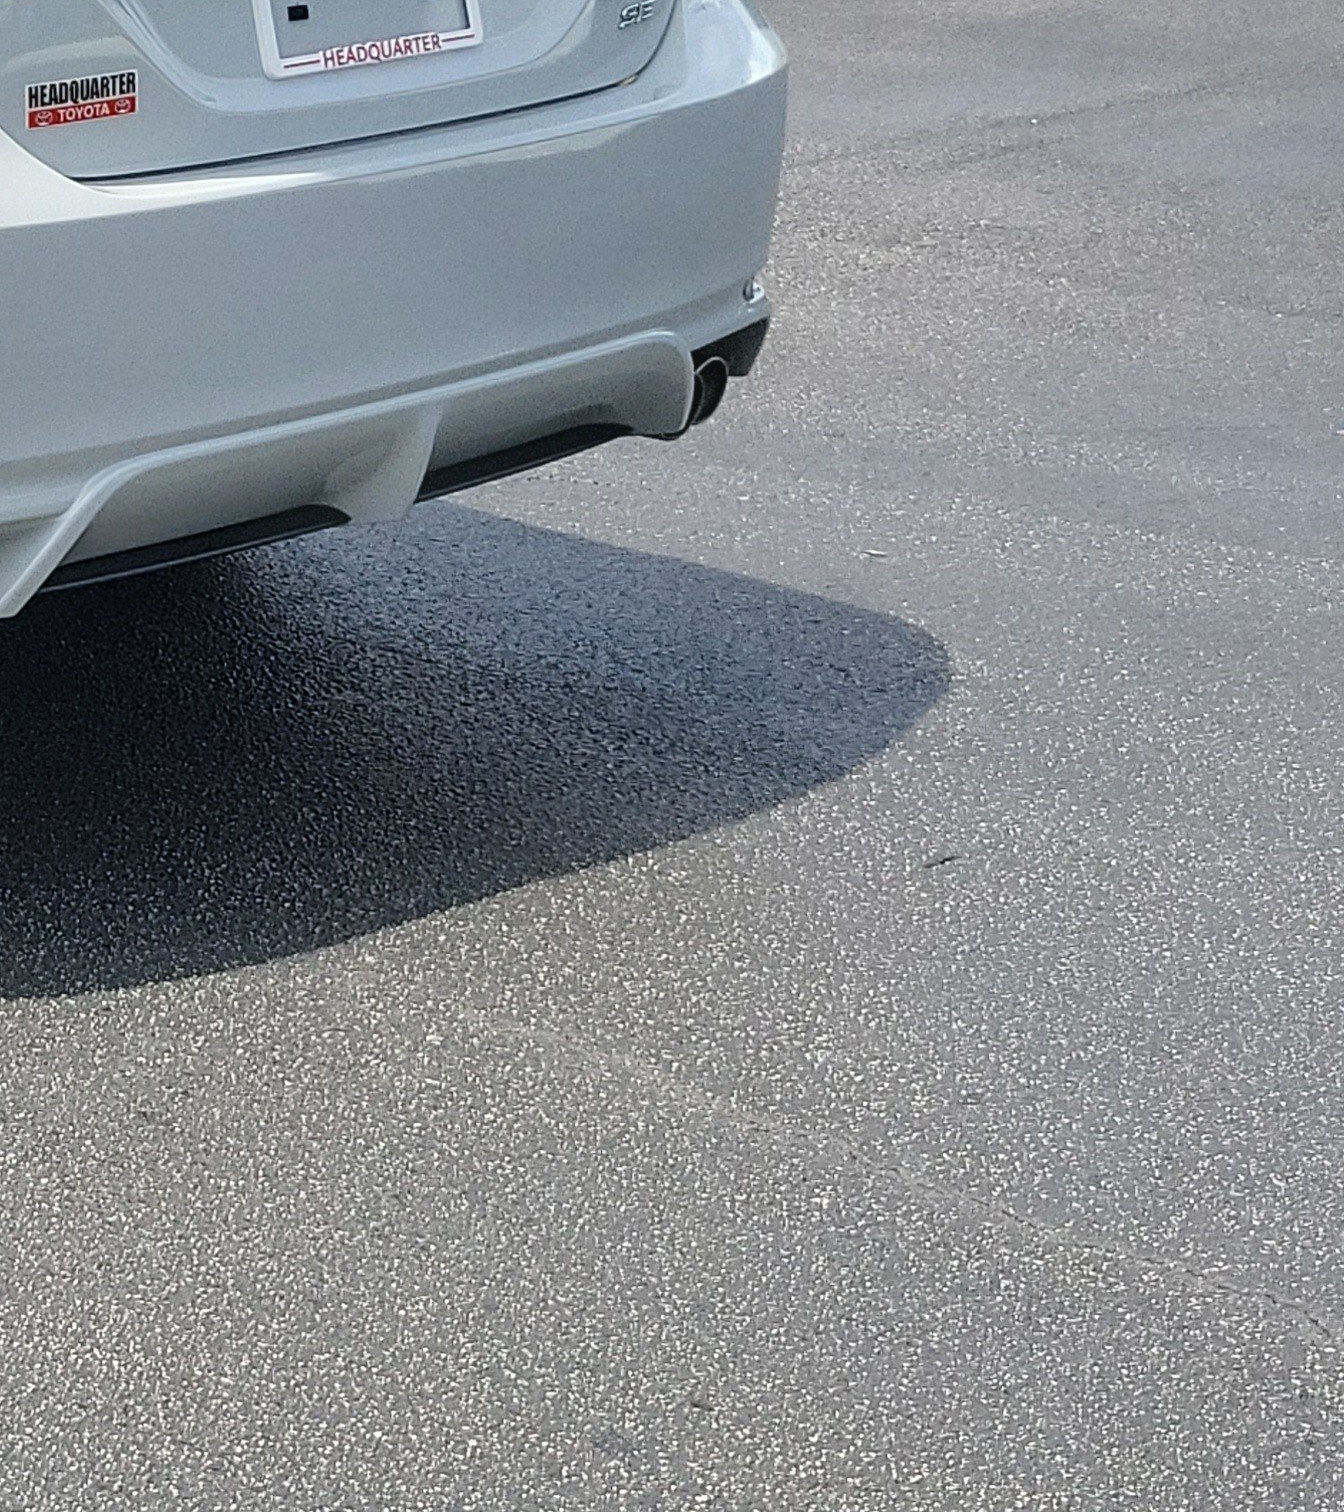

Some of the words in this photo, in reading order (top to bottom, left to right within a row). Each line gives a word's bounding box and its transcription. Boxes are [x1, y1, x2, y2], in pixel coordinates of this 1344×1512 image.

[322, 33, 442, 69] HEADQUARTER
[28, 72, 136, 109] HEADQUARTER
[57, 103, 110, 122] TOYOTA
